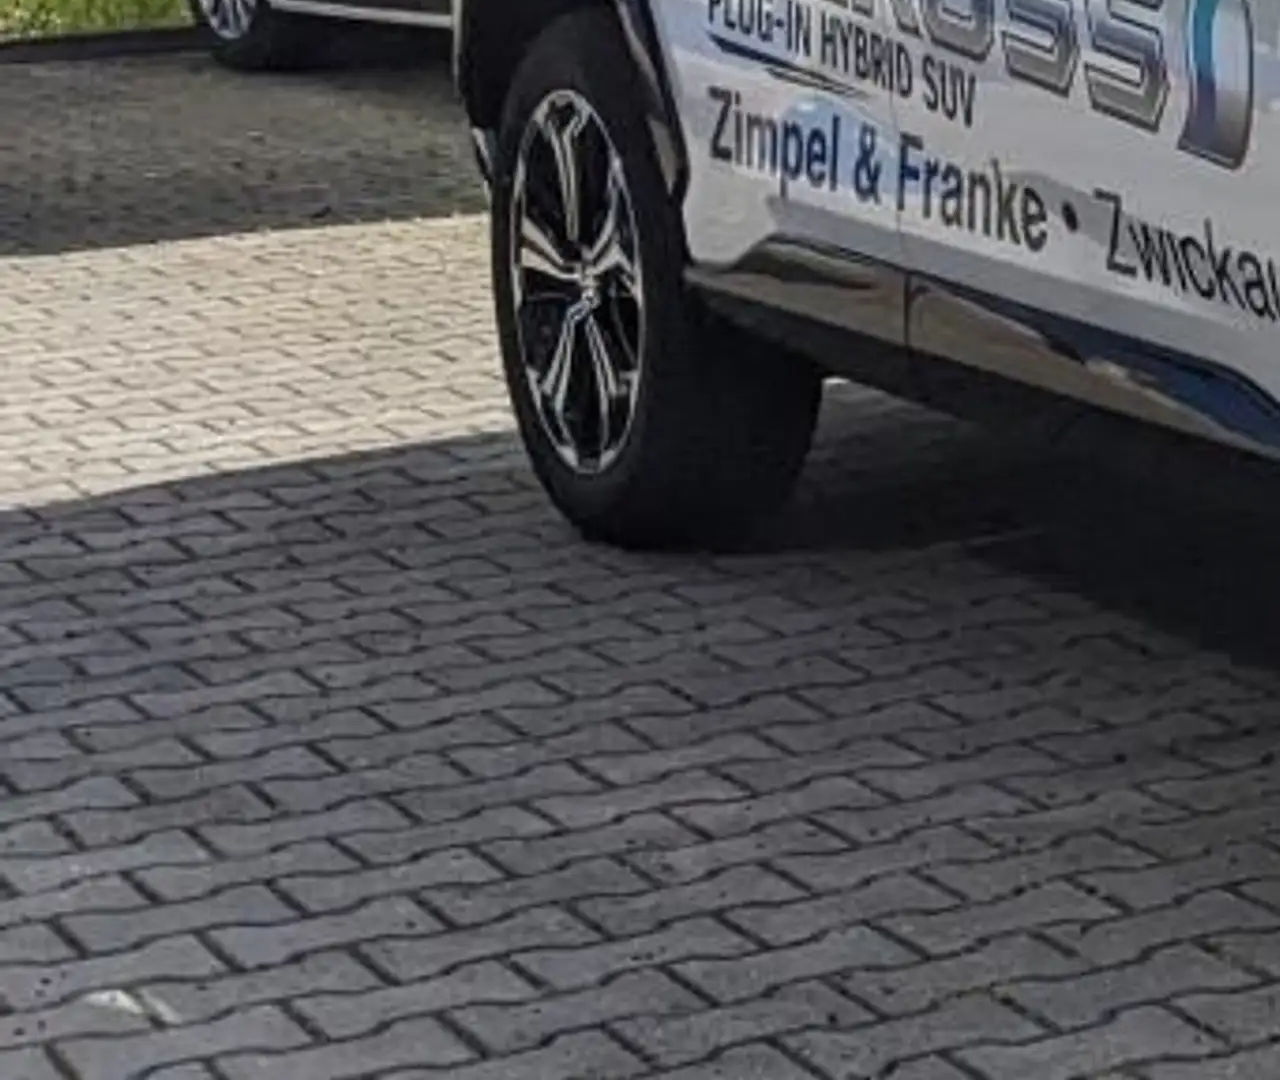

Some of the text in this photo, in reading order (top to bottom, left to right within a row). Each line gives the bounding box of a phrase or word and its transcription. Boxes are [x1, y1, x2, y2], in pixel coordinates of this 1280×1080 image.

[820, 10, 913, 99] HYBRID
[921, 54, 977, 128] SUV
[707, 85, 842, 198] Zimpel
[853, 121, 882, 205] &
[897, 130, 1049, 252] Franke
